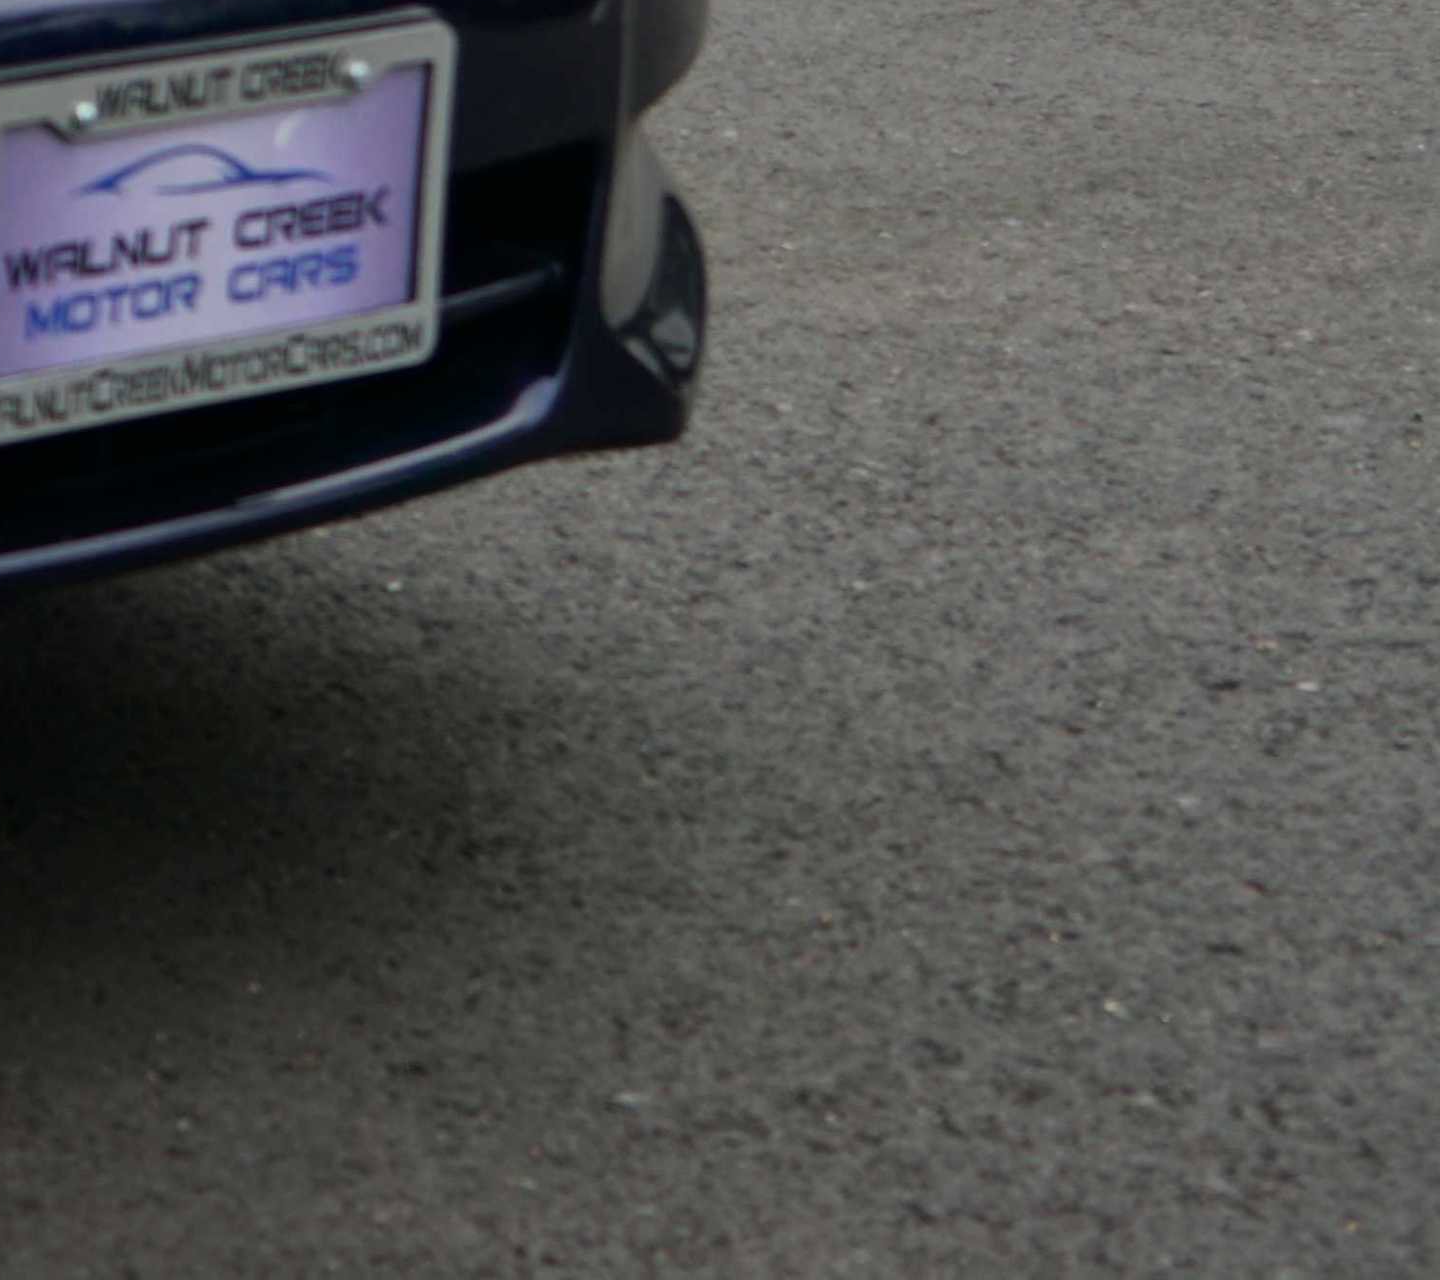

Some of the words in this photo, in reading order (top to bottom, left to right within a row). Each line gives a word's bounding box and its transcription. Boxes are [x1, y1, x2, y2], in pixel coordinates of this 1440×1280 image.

[96, 66, 233, 120] WALNUT
[238, 47, 354, 102] CREEK
[3, 217, 210, 291] WALNUT
[233, 185, 389, 250] CREEK
[24, 271, 202, 341] MOTOR
[226, 243, 360, 303] CARS
